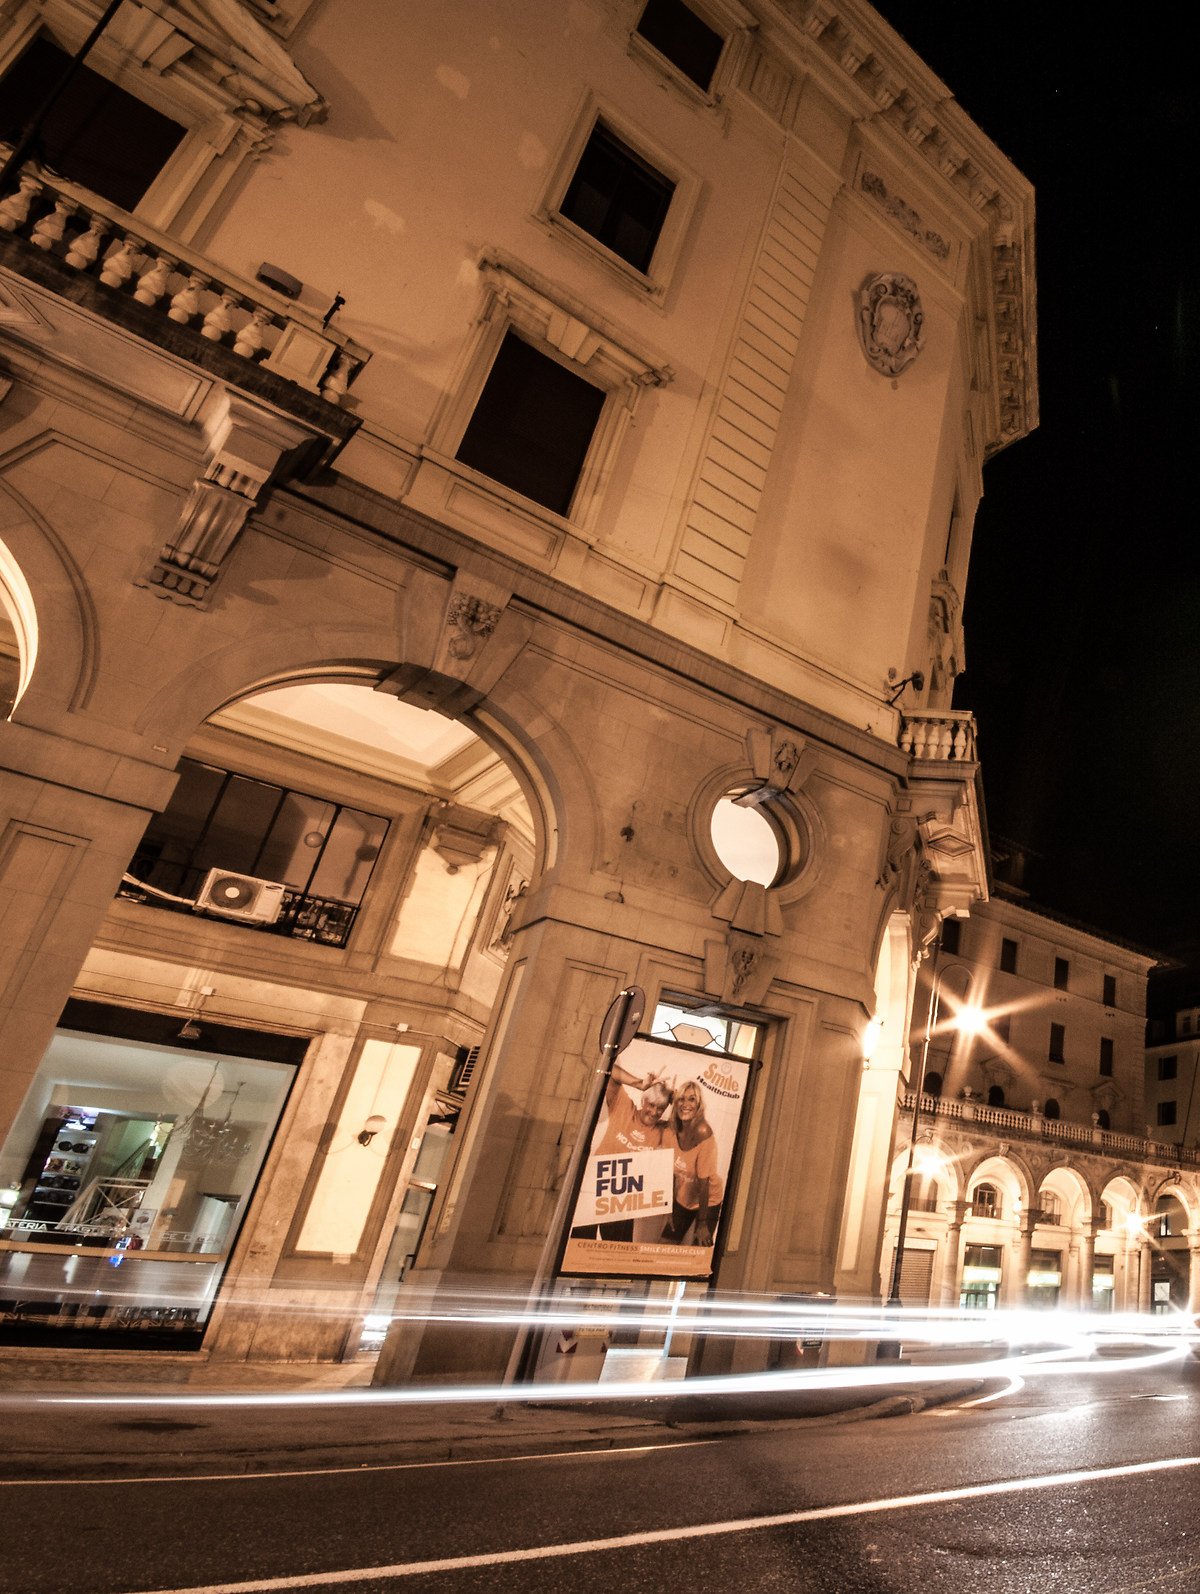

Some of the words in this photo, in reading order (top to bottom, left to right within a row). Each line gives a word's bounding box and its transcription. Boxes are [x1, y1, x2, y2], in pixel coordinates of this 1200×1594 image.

[696, 1075, 740, 1099] HealthClub
[704, 1063, 739, 1092] Smile
[597, 1158, 633, 1178] FIT
[596, 1175, 644, 1197] FUN
[577, 1241, 608, 1250] CENTRO
[609, 1243, 638, 1251] FITNESS
[640, 1245, 660, 1253] SMILE
[661, 1246, 688, 1254] HEALTH
[688, 1247, 706, 1255] CLUB
